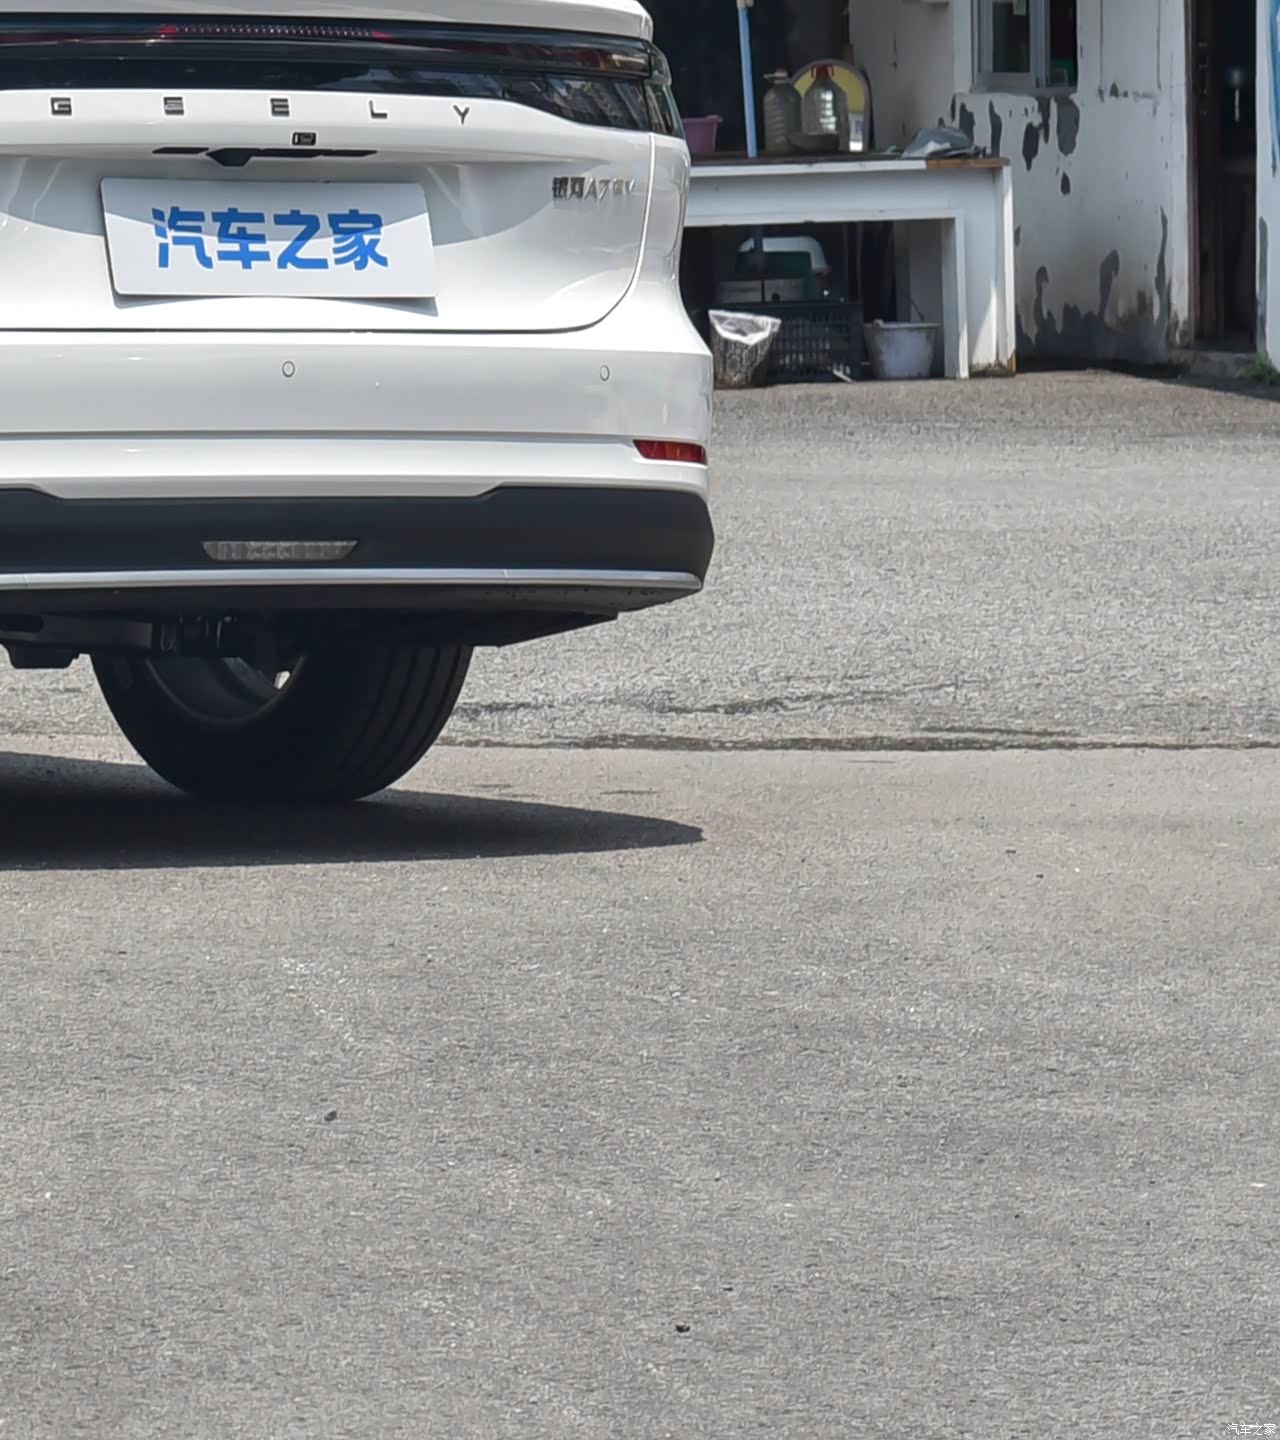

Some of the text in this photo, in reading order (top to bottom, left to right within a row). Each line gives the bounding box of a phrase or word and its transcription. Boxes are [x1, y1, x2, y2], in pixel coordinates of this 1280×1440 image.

[50, 96, 471, 125] GEELY
[151, 206, 389, 271] 汽车之家
